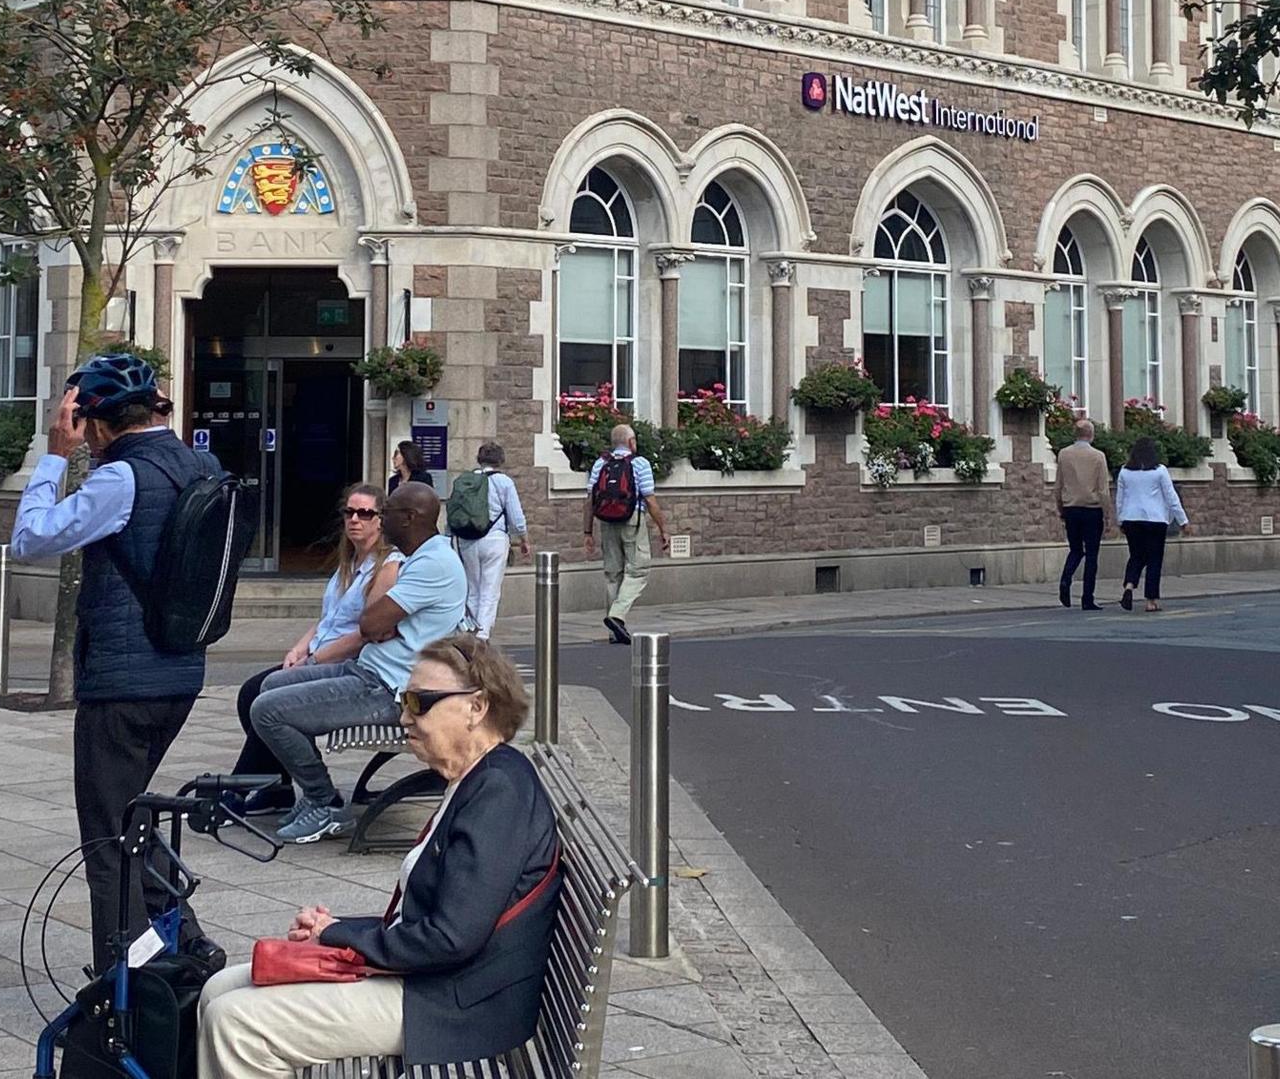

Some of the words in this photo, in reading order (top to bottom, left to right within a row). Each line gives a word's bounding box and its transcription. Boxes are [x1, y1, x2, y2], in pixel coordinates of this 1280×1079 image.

[834, 74, 930, 124] NatWest
[934, 98, 1040, 141] International
[216, 231, 335, 254] BANK
